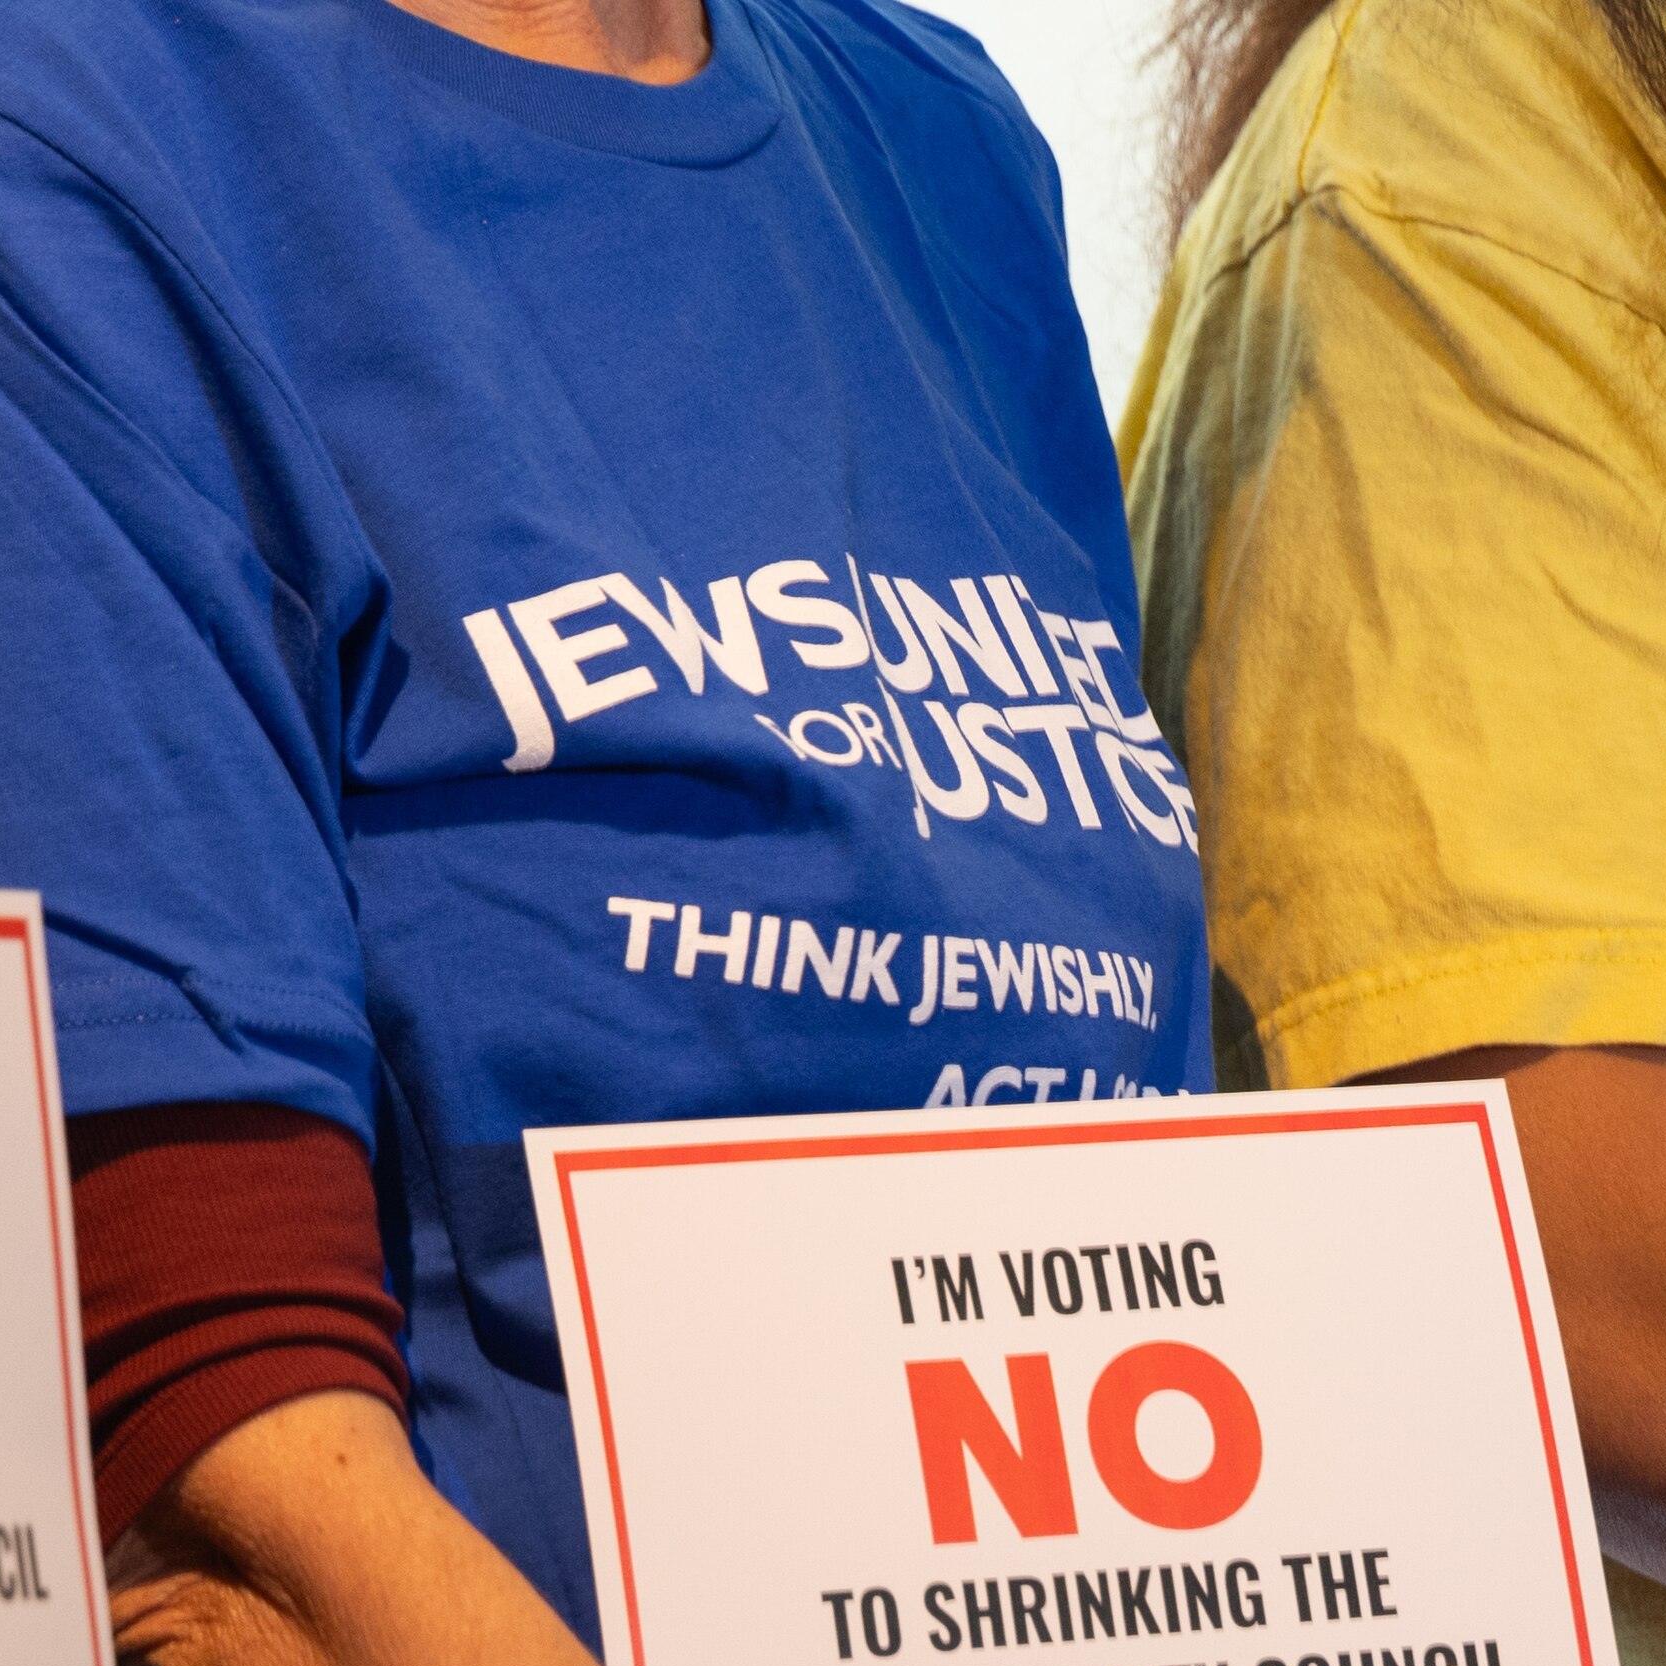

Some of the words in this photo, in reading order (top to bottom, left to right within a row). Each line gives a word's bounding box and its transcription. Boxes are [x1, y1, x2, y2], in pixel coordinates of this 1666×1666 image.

[462, 559, 870, 773] JEWS
[845, 552, 1162, 742] UNIED
[754, 702, 902, 770] OR
[876, 675, 1200, 858] USTCE
[607, 896, 902, 1004] THINK
[909, 933, 1158, 1031] JEWISHLY.
[890, 1253, 984, 1325] I'M
[999, 1239, 1226, 1318] VOTING
[904, 1339, 1263, 1545] NO
[821, 1587, 901, 1661] TO
[926, 1557, 1267, 1654] SHRINKING
[1282, 1548, 1397, 1624] THE
